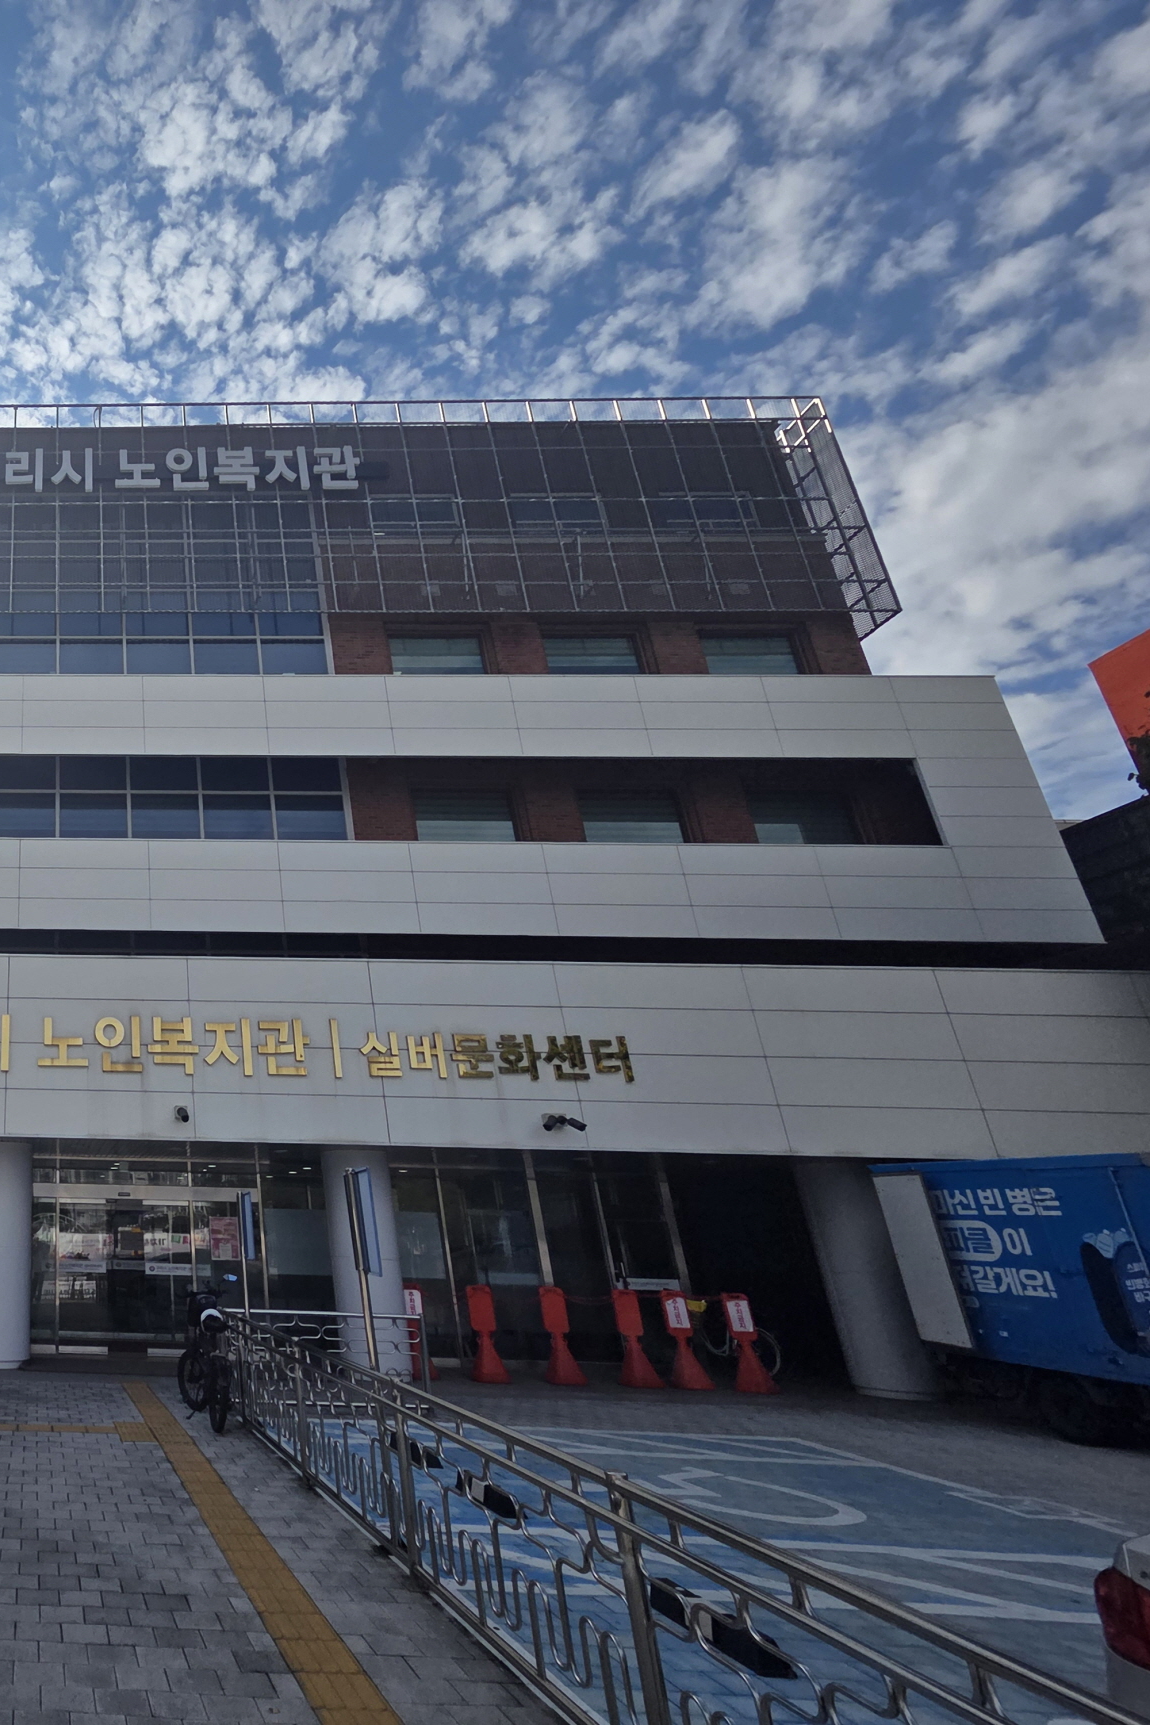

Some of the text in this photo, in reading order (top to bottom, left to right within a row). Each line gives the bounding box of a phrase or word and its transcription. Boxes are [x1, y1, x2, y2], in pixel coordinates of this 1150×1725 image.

[114, 445, 360, 492] 노인복지관
[37, 1015, 310, 1076] 노인복지관
[360, 1031, 635, 1083] 실버문화센터
